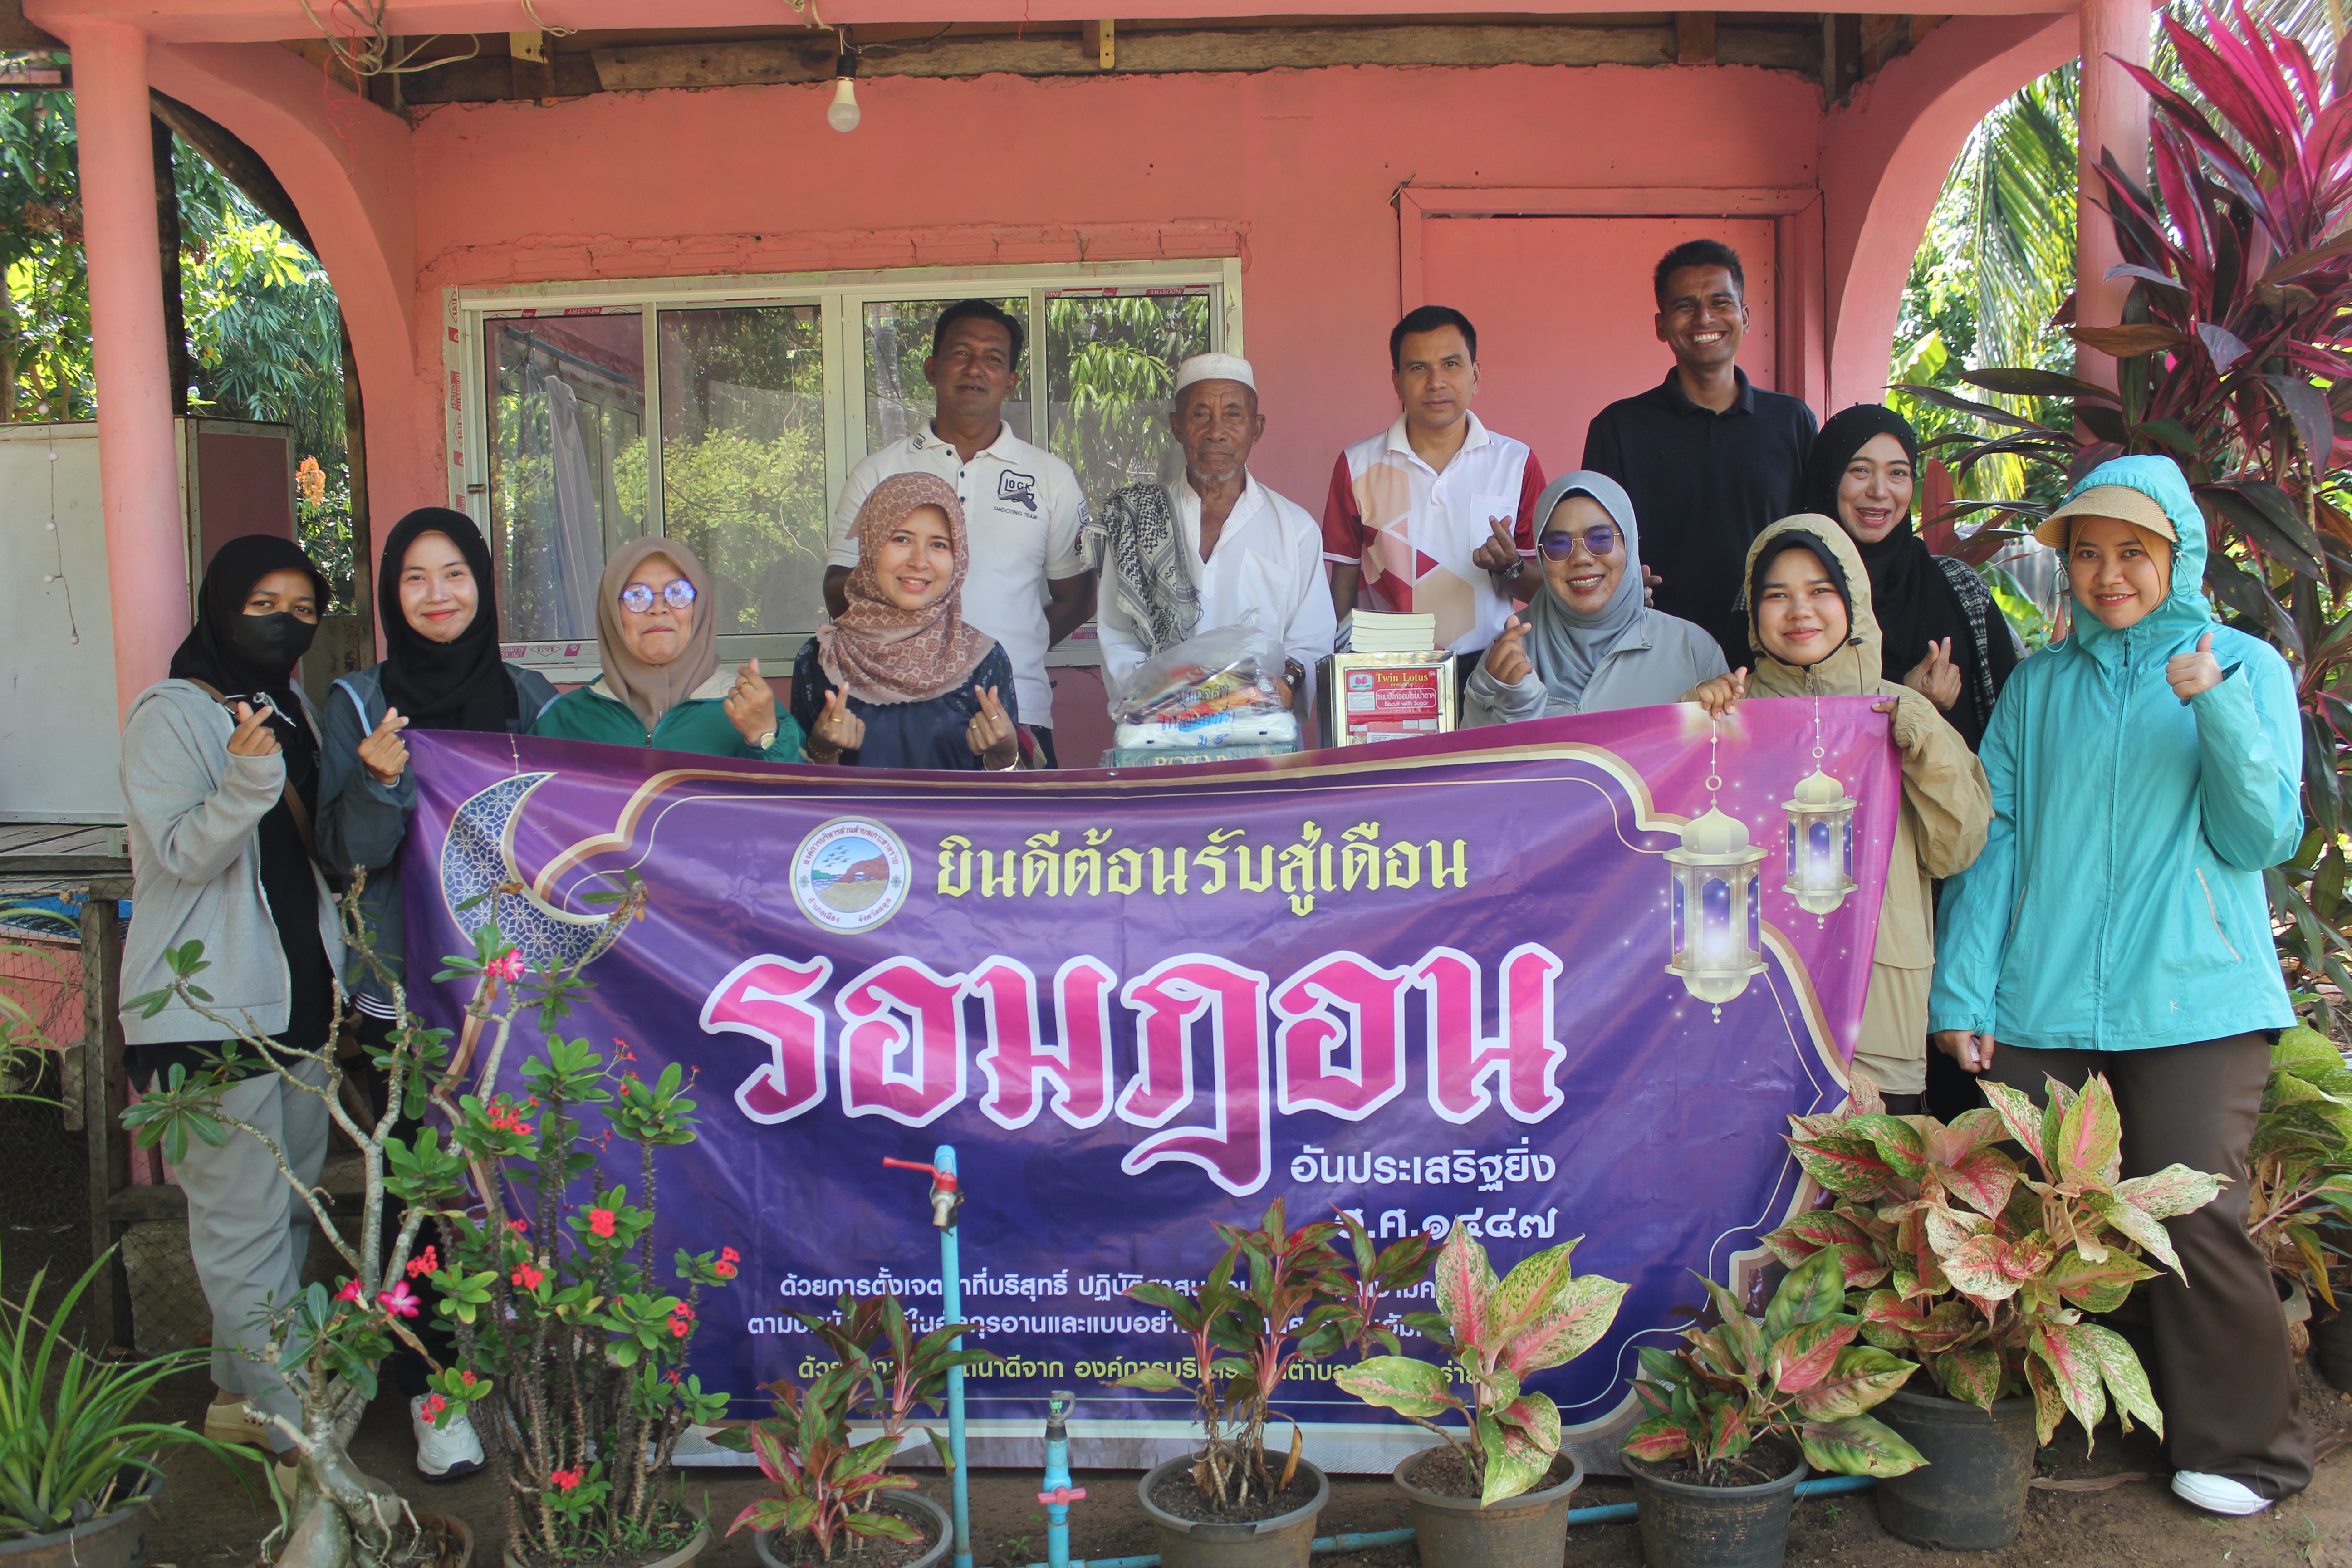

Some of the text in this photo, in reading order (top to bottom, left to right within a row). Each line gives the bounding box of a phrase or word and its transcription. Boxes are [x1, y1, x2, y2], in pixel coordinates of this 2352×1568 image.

[994, 506, 1022, 516] SHOOTING
[1375, 672, 1429, 682] Twin Lotus
[936, 820, 1468, 917] ยินดีต้อนรับสู่เดือน
[808, 897, 840, 923] อำเภอเมือง
[698, 942, 1566, 1197] รอมฎอน
[1290, 1137, 1556, 1192] อันประเสริฐยิ่ง
[780, 1267, 1068, 1302] ด้วยการตั้งเจตาที่บริสุทธิ์
